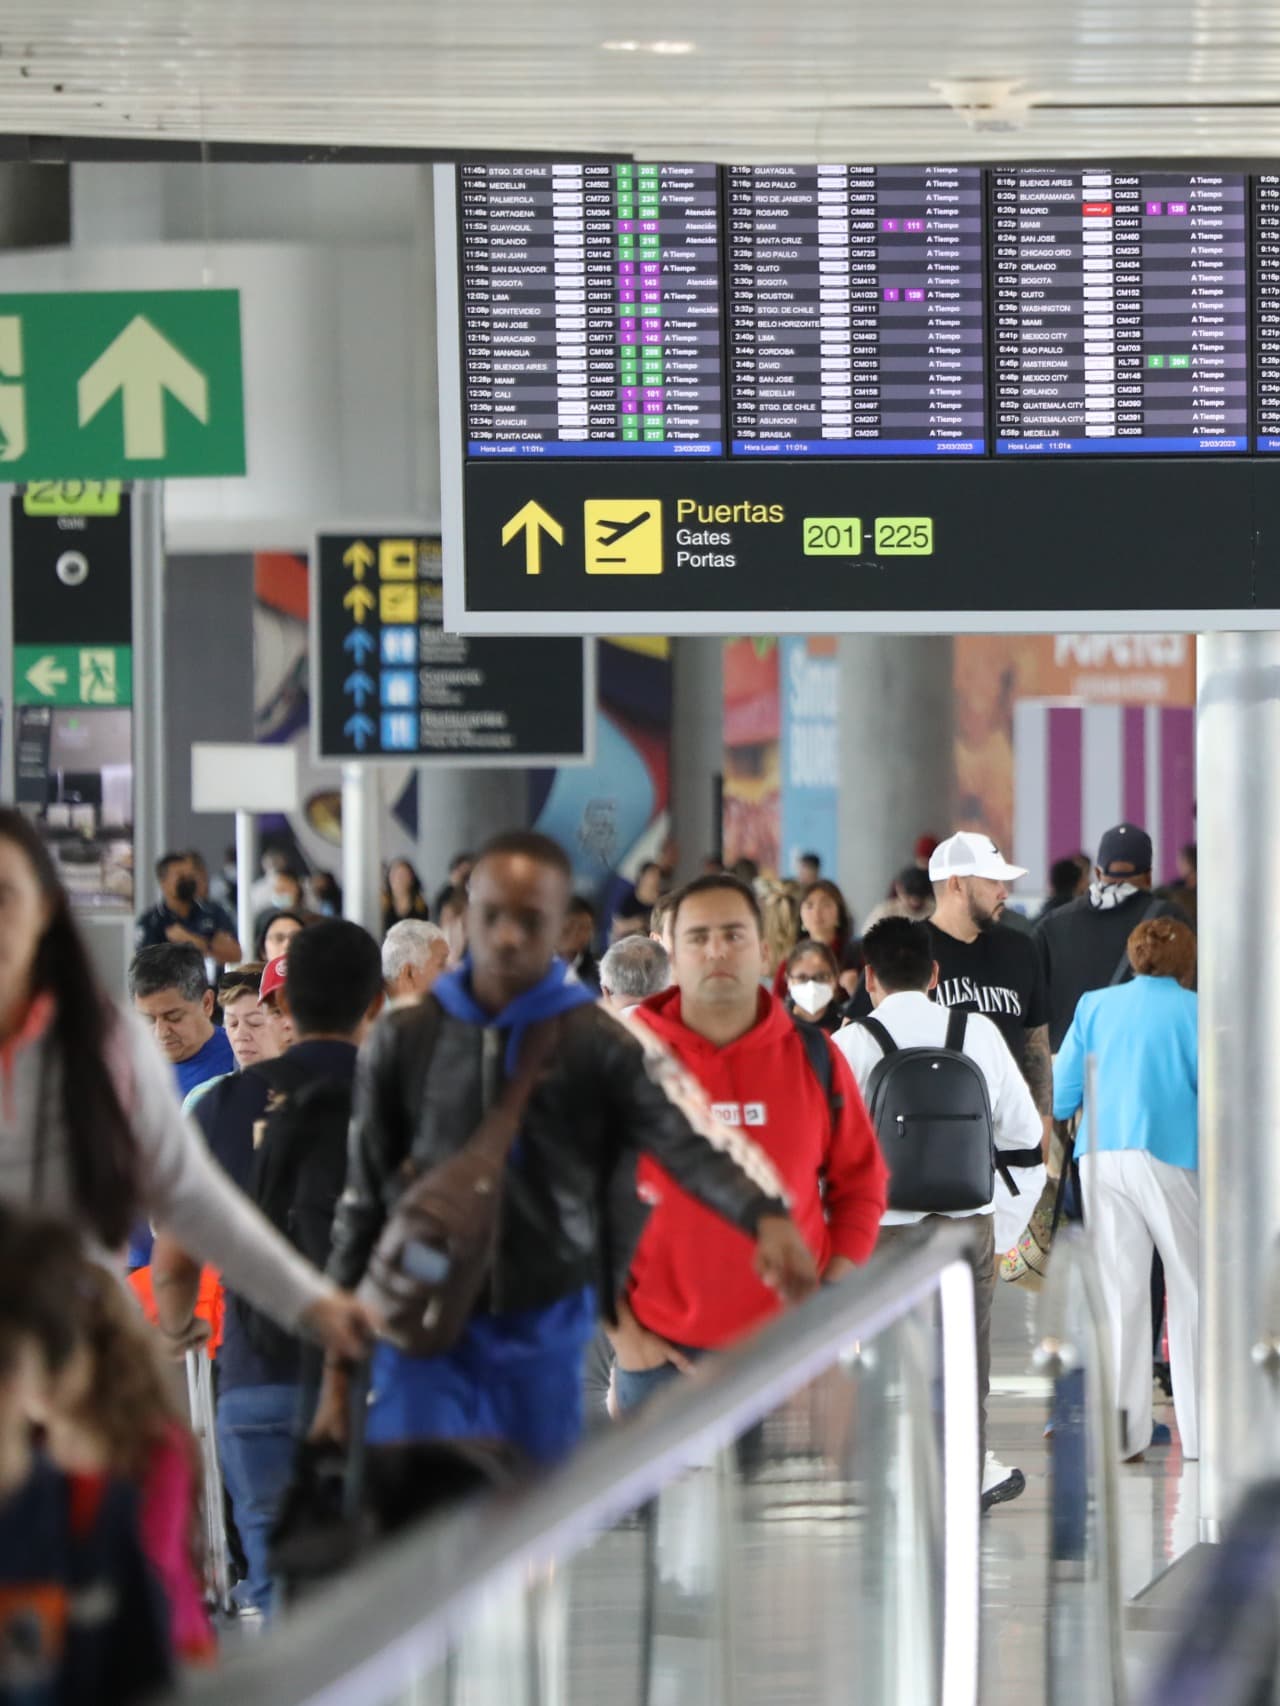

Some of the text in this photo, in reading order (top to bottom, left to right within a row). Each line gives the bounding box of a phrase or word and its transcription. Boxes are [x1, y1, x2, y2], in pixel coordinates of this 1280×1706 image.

[489, 182, 526, 190] MEDELLIN
[755, 180, 796, 190] SAO PAULO
[1020, 180, 1049, 188] BUENOS
[1051, 178, 1073, 188] AIRES
[1197, 176, 1222, 186] Tiempo
[490, 208, 716, 218] CARTAGENA Atención
[756, 208, 789, 216] ROSARIO
[490, 224, 532, 232] GUAYAQUIL
[491, 238, 527, 246] ORLANDO
[756, 236, 780, 244] SANTA
[781, 236, 802, 244] CRUZ
[491, 252, 507, 260] SAN
[507, 252, 527, 260] JUAN
[669, 250, 696, 260] Tiempo
[1020, 248, 1071, 258] CHICAGO ORD
[492, 266, 547, 274] SAN SALVADOR
[756, 264, 780, 272] QUITO
[1021, 262, 1056, 270] ORLANDO
[492, 280, 523, 288] BOGOTA
[757, 278, 788, 286] BOGOTA
[492, 294, 509, 302] LIMA
[757, 292, 794, 300] HOUSTON
[1021, 290, 1045, 298] QUITO
[493, 308, 541, 316] MONTEVIDEO
[758, 306, 778, 314] STGO.
[792, 306, 814, 314] CHILE
[758, 320, 820, 328] BELO HORIZONTE
[1022, 318, 1042, 326] MIAMI
[1022, 332, 1067, 340] MEXICO CITY
[494, 350, 530, 358] MANAGUA
[758, 348, 794, 356] CORDOBA
[759, 362, 780, 370] DAVID
[1023, 402, 1084, 410] GUATEMALA CITY
[495, 418, 527, 426] CANCUN
[496, 432, 542, 440] PUNTA CANA
[676, 499, 784, 524] Puertas
[676, 529, 731, 546] Gates
[807, 525, 929, 549] 201 225
[676, 551, 736, 568] Portas
[936, 976, 1021, 1016] ALLSAINTS
